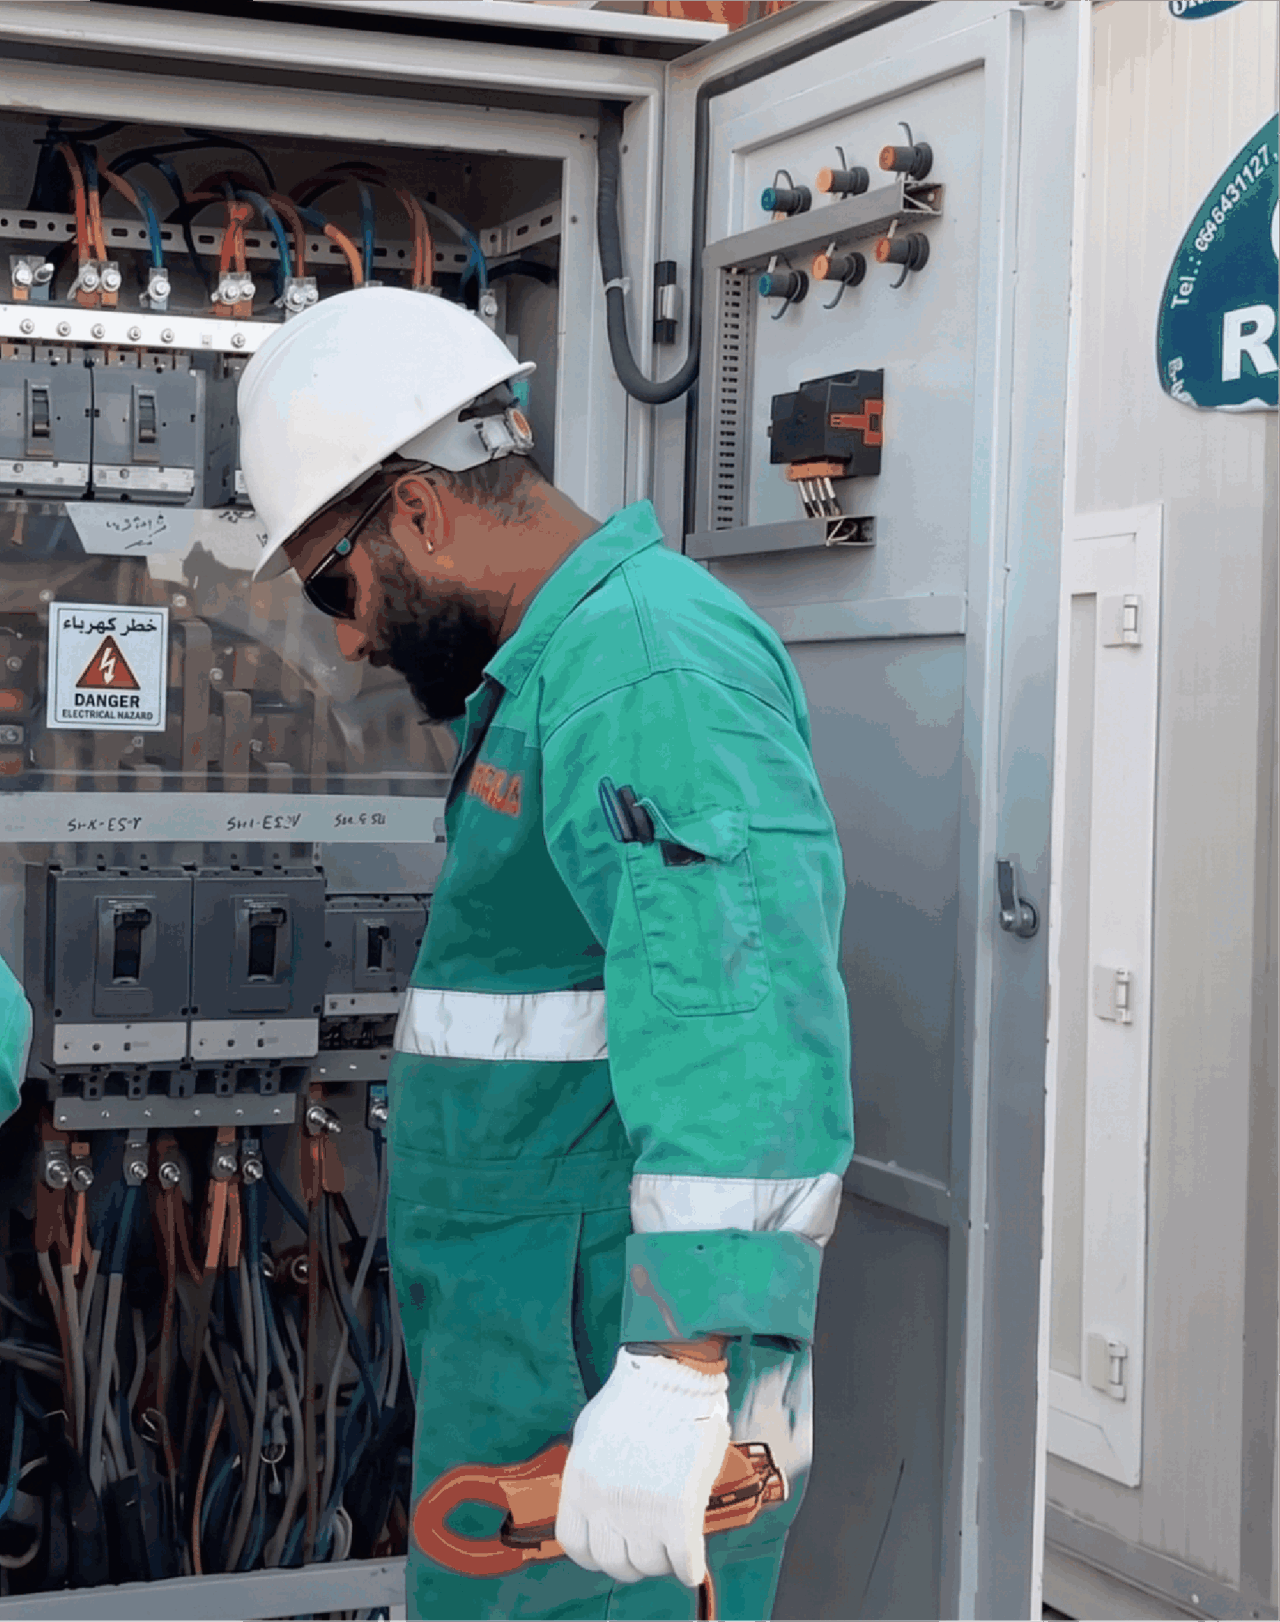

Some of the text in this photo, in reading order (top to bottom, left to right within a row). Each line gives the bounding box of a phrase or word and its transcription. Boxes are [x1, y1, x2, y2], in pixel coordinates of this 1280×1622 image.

[63, 616, 157, 636] خطر كهرباء
[74, 693, 140, 709] DANGER
[62, 709, 115, 719] ELECTRICAL
